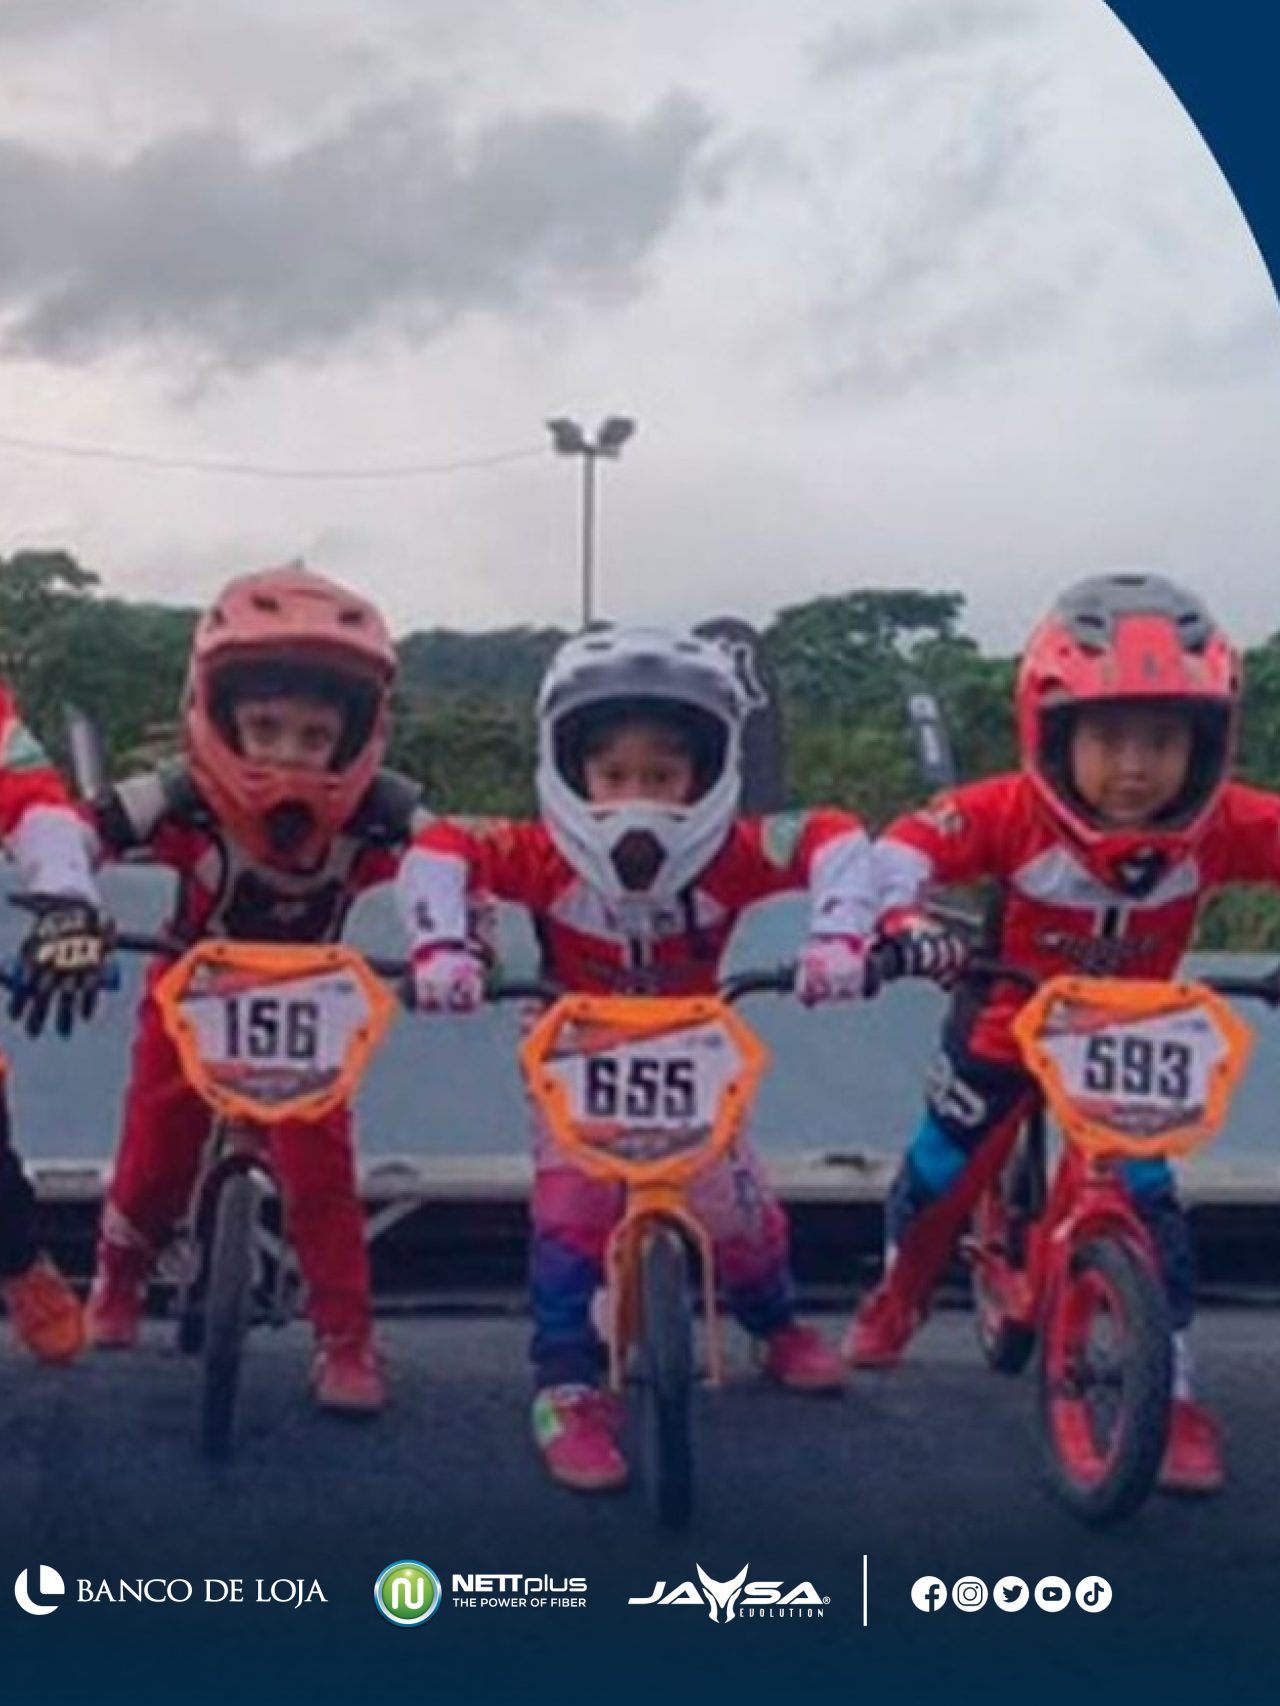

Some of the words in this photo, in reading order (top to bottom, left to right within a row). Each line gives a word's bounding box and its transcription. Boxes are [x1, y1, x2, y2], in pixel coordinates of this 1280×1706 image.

[226, 998, 318, 1058] 156
[587, 1057, 696, 1118] 655
[1085, 1036, 1189, 1098] 593
